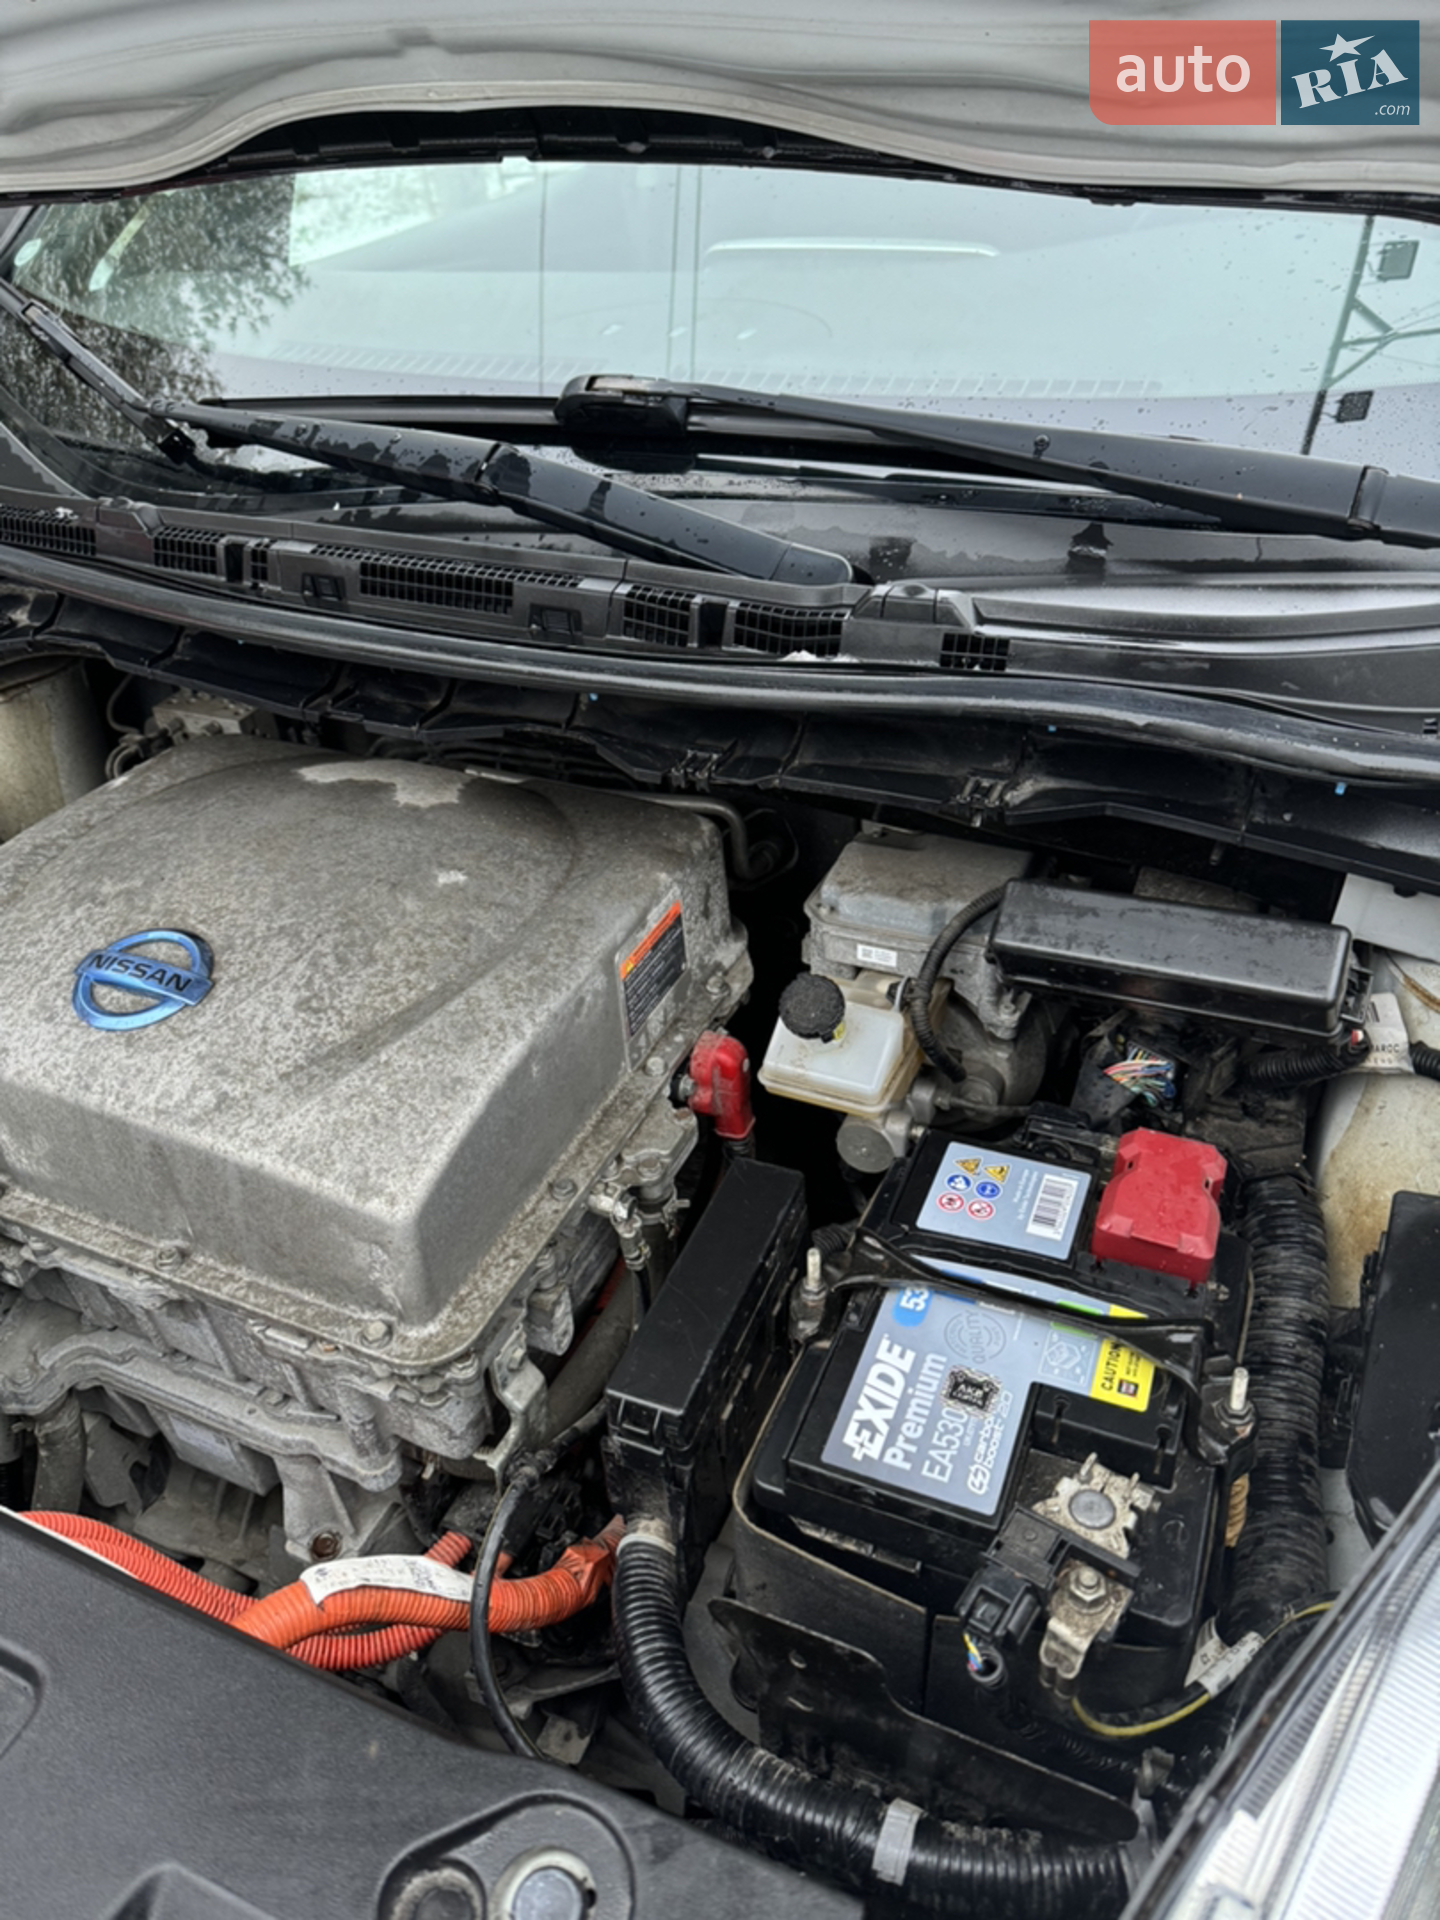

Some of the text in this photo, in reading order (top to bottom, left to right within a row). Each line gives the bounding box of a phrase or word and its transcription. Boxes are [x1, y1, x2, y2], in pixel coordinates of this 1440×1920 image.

[89, 954, 193, 992] NISSAN
[966, 1310, 987, 1363] QUALITY
[842, 1340, 917, 1462] EXIDE
[883, 1351, 948, 1471] Premium
[921, 1408, 969, 1485] EA530
